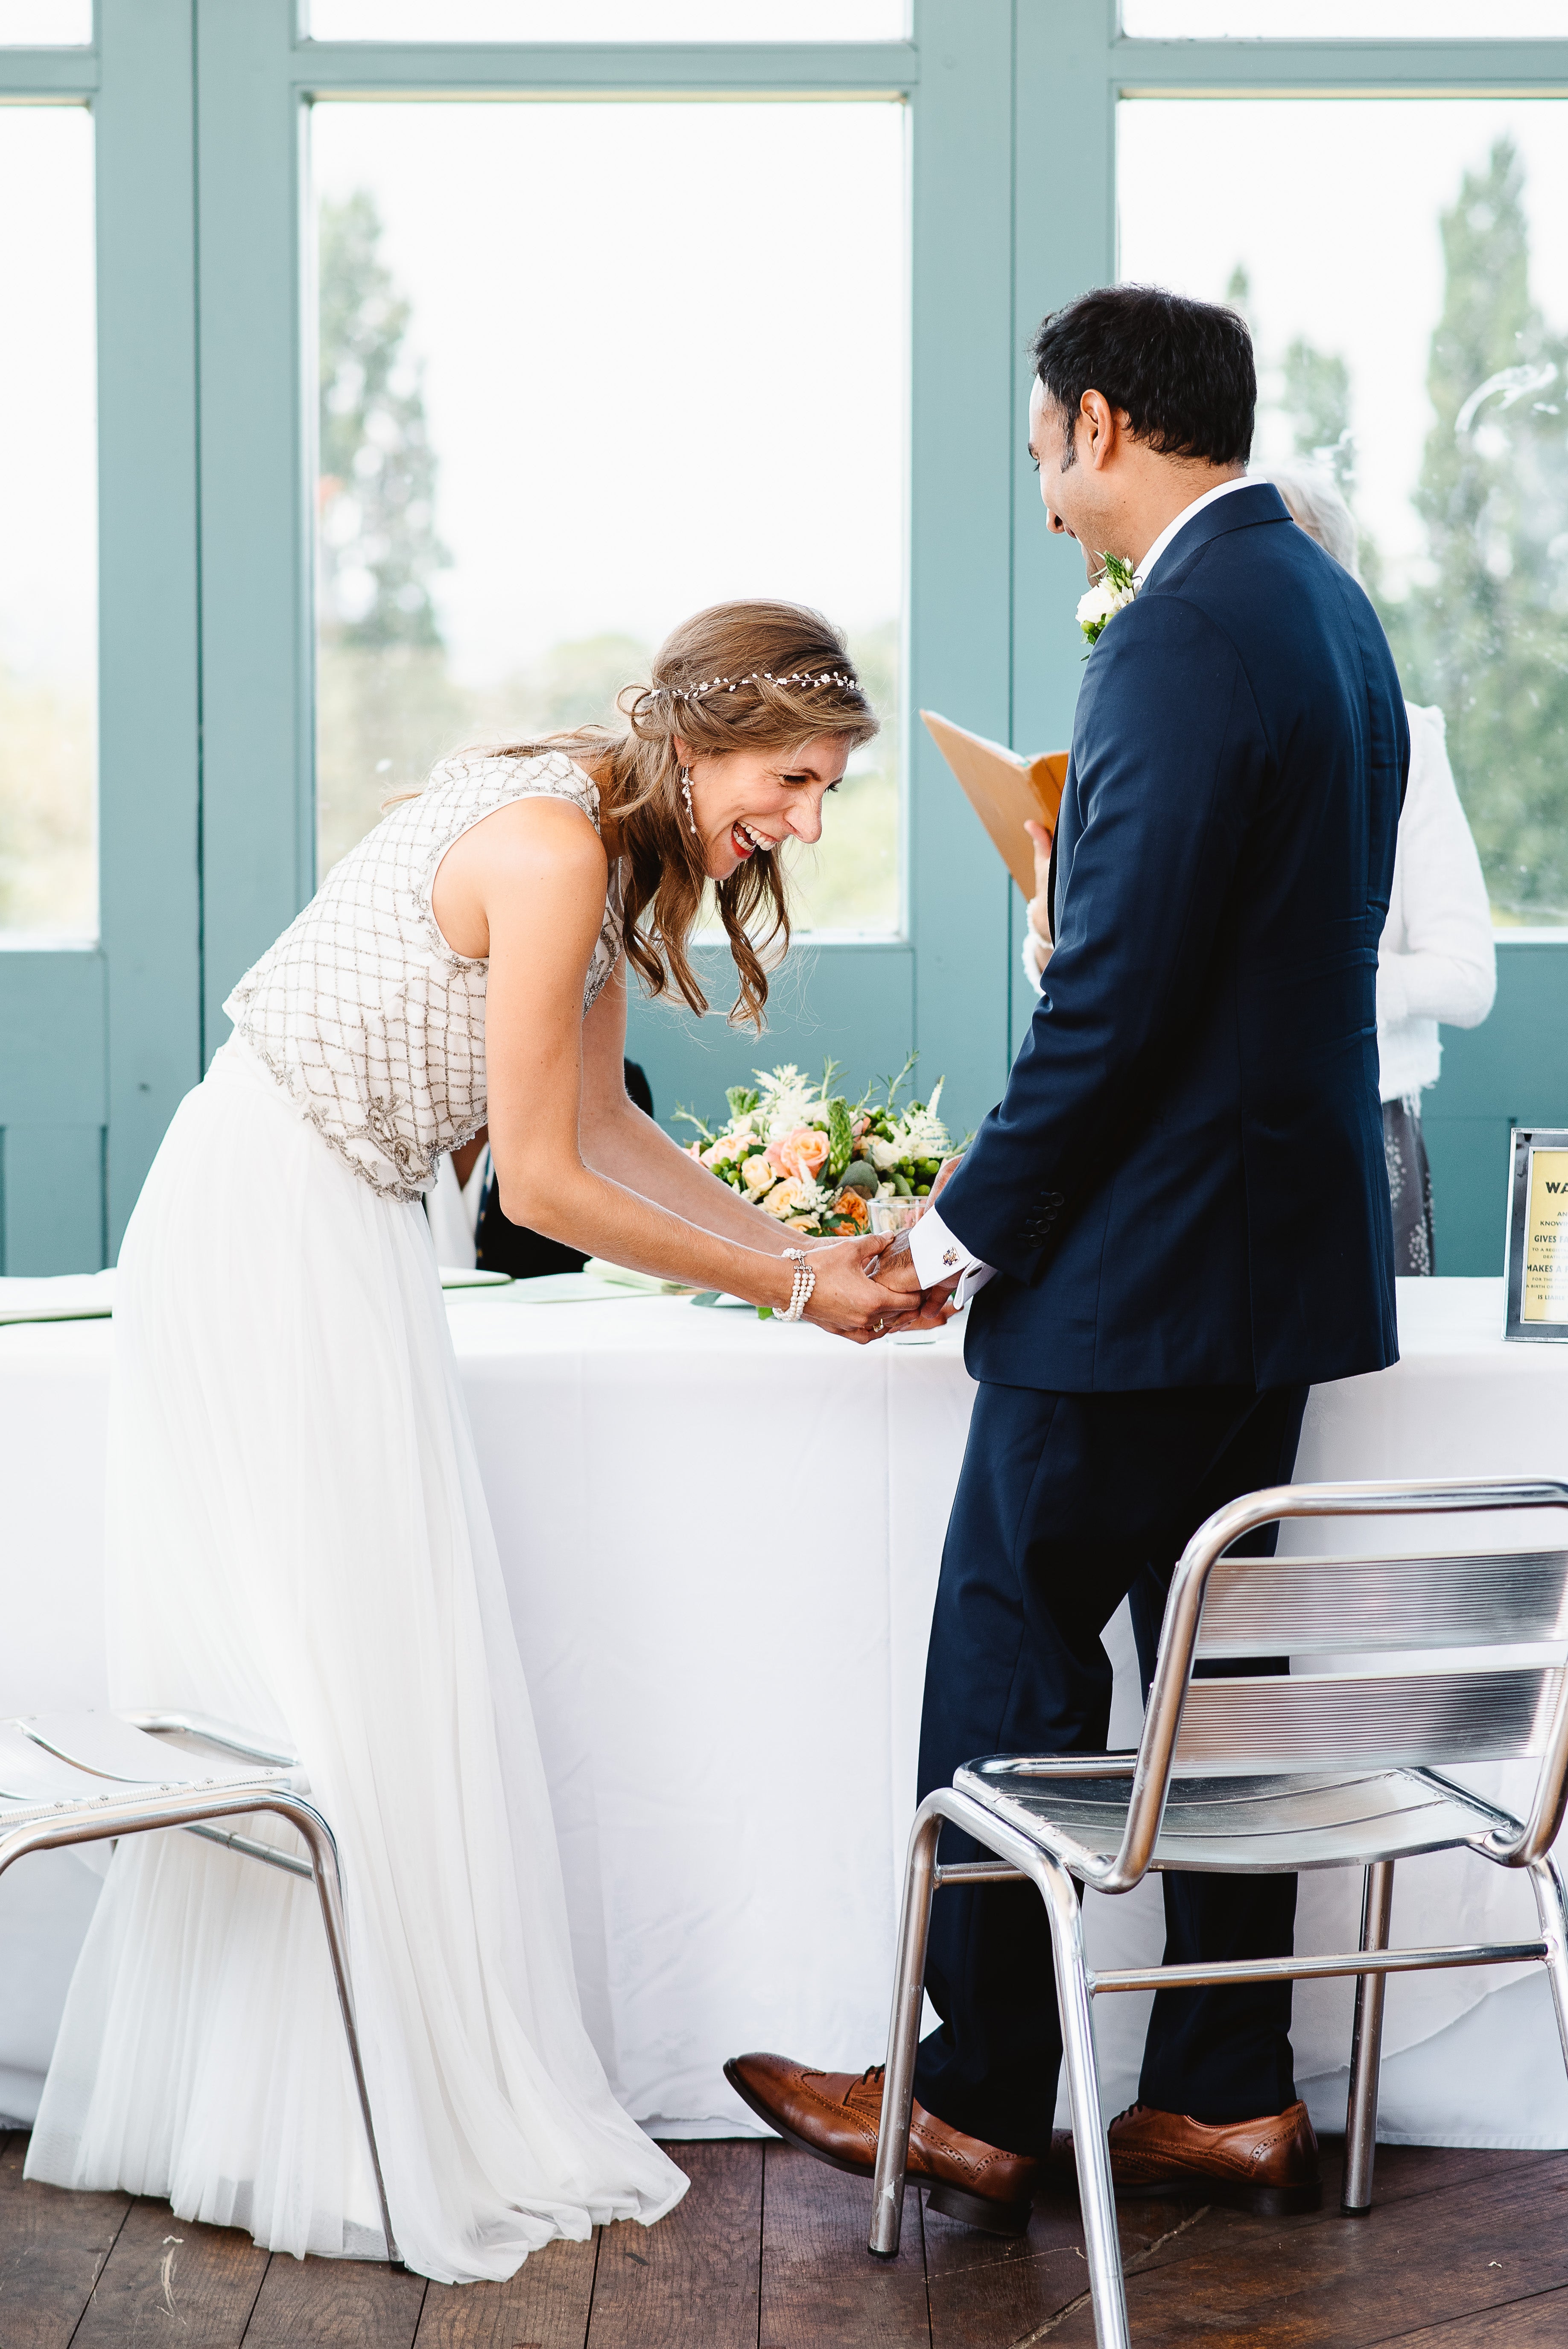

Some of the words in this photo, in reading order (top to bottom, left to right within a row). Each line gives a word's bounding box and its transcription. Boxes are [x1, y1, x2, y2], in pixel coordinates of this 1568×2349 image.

[1545, 1182, 1568, 1193] WA
[1534, 1235, 1556, 1243] GIVES
[1527, 1264, 1553, 1272] MAKES
